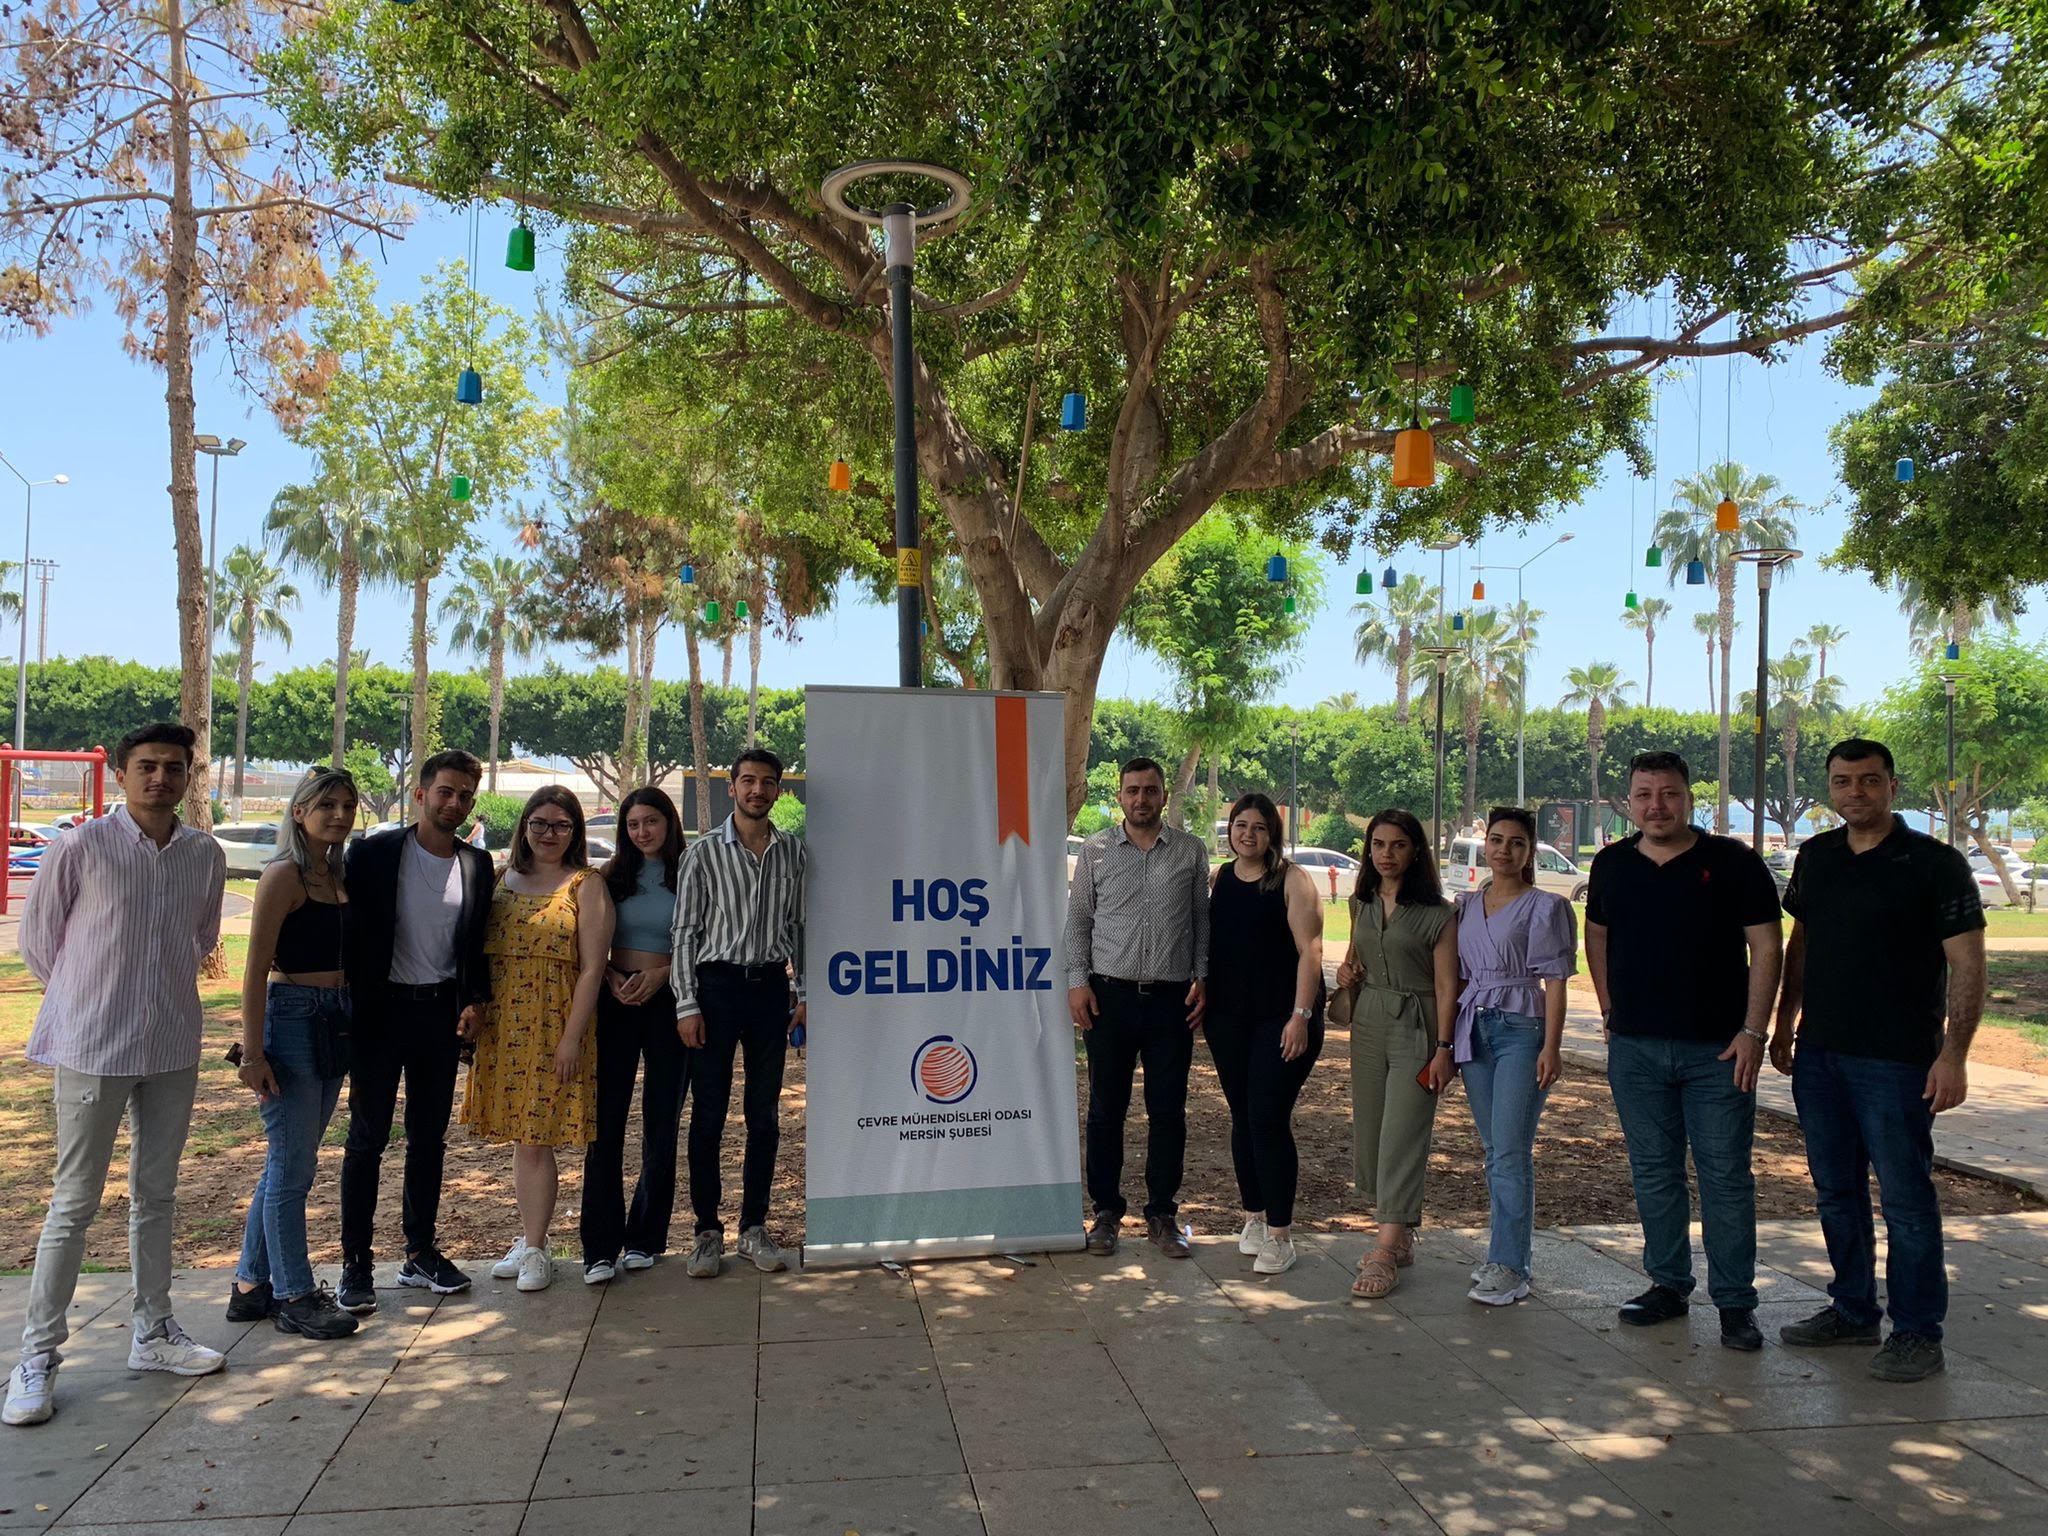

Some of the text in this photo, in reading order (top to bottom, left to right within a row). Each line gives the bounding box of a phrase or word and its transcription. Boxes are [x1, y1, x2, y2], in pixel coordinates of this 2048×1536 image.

[892, 878, 990, 927] HOŞ
[828, 935, 1052, 995] GELDİNİZ
[857, 1109, 1032, 1130] ÇEVRE MÜHENDİSLERİ ODASI
[899, 1124, 992, 1141] MERSİN ŞUBESİ
